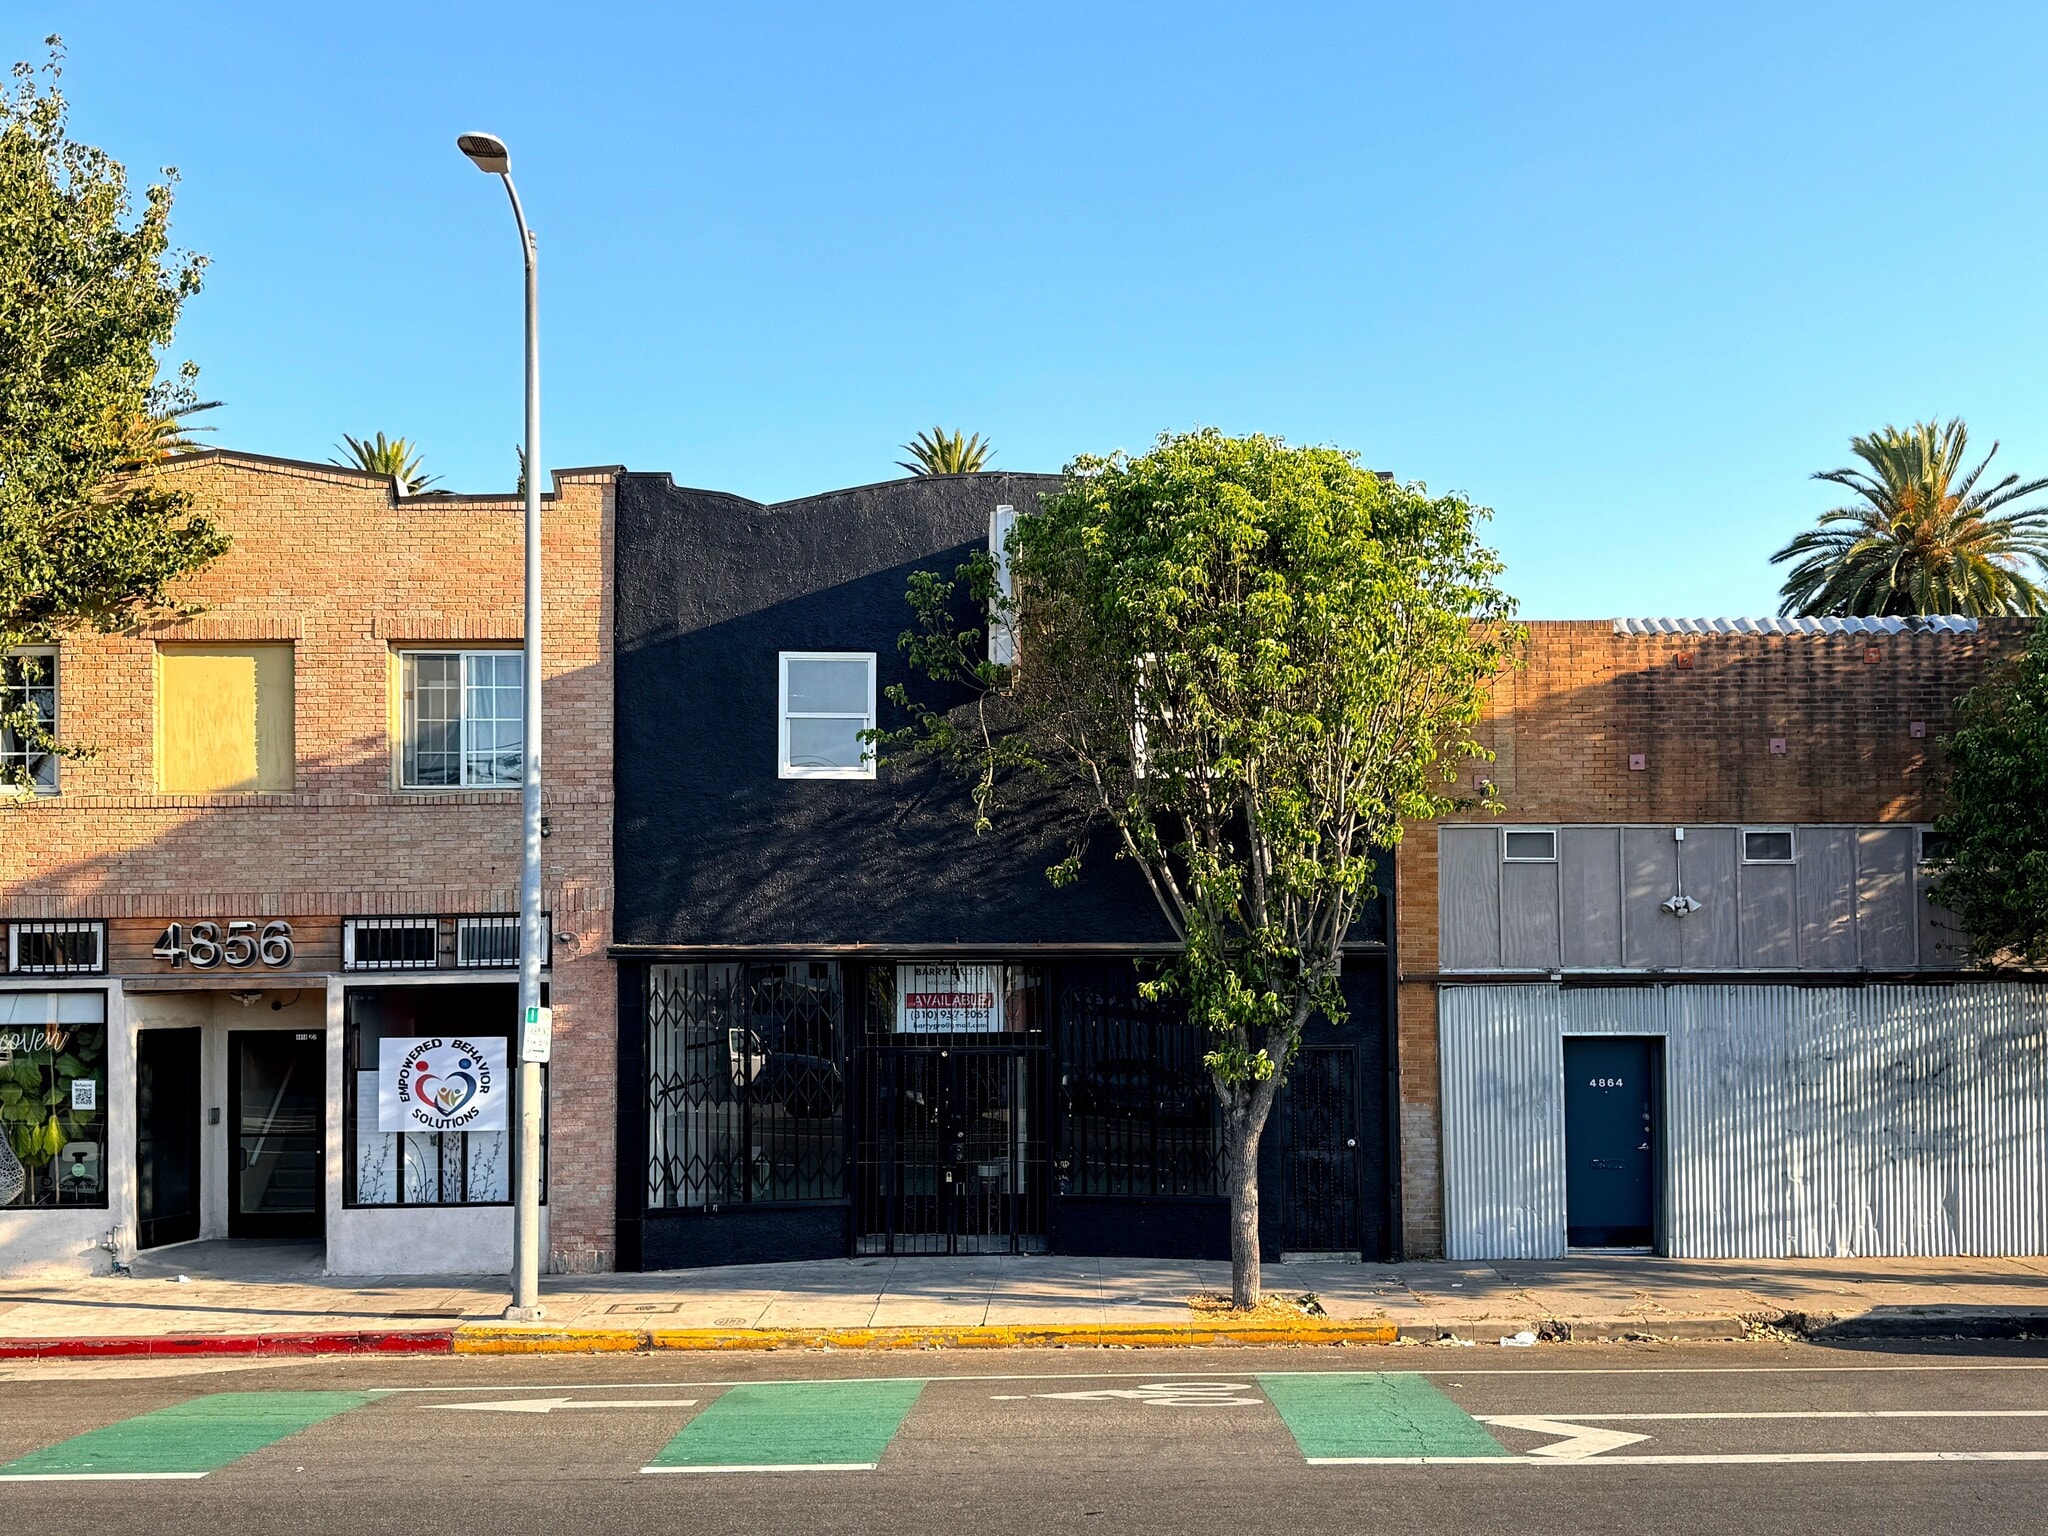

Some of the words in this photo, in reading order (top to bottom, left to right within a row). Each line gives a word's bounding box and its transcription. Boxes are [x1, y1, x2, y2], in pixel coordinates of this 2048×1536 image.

[152, 920, 295, 969] 4856
[915, 967, 948, 976] BARRY
[913, 994, 988, 1006] AVAILABLE
[398, 1038, 442, 1103] EMPOWERED
[451, 1039, 491, 1095] BEHAVIOR
[1589, 1078, 1624, 1088] 4864
[412, 1106, 480, 1129] SOLUTIONS
